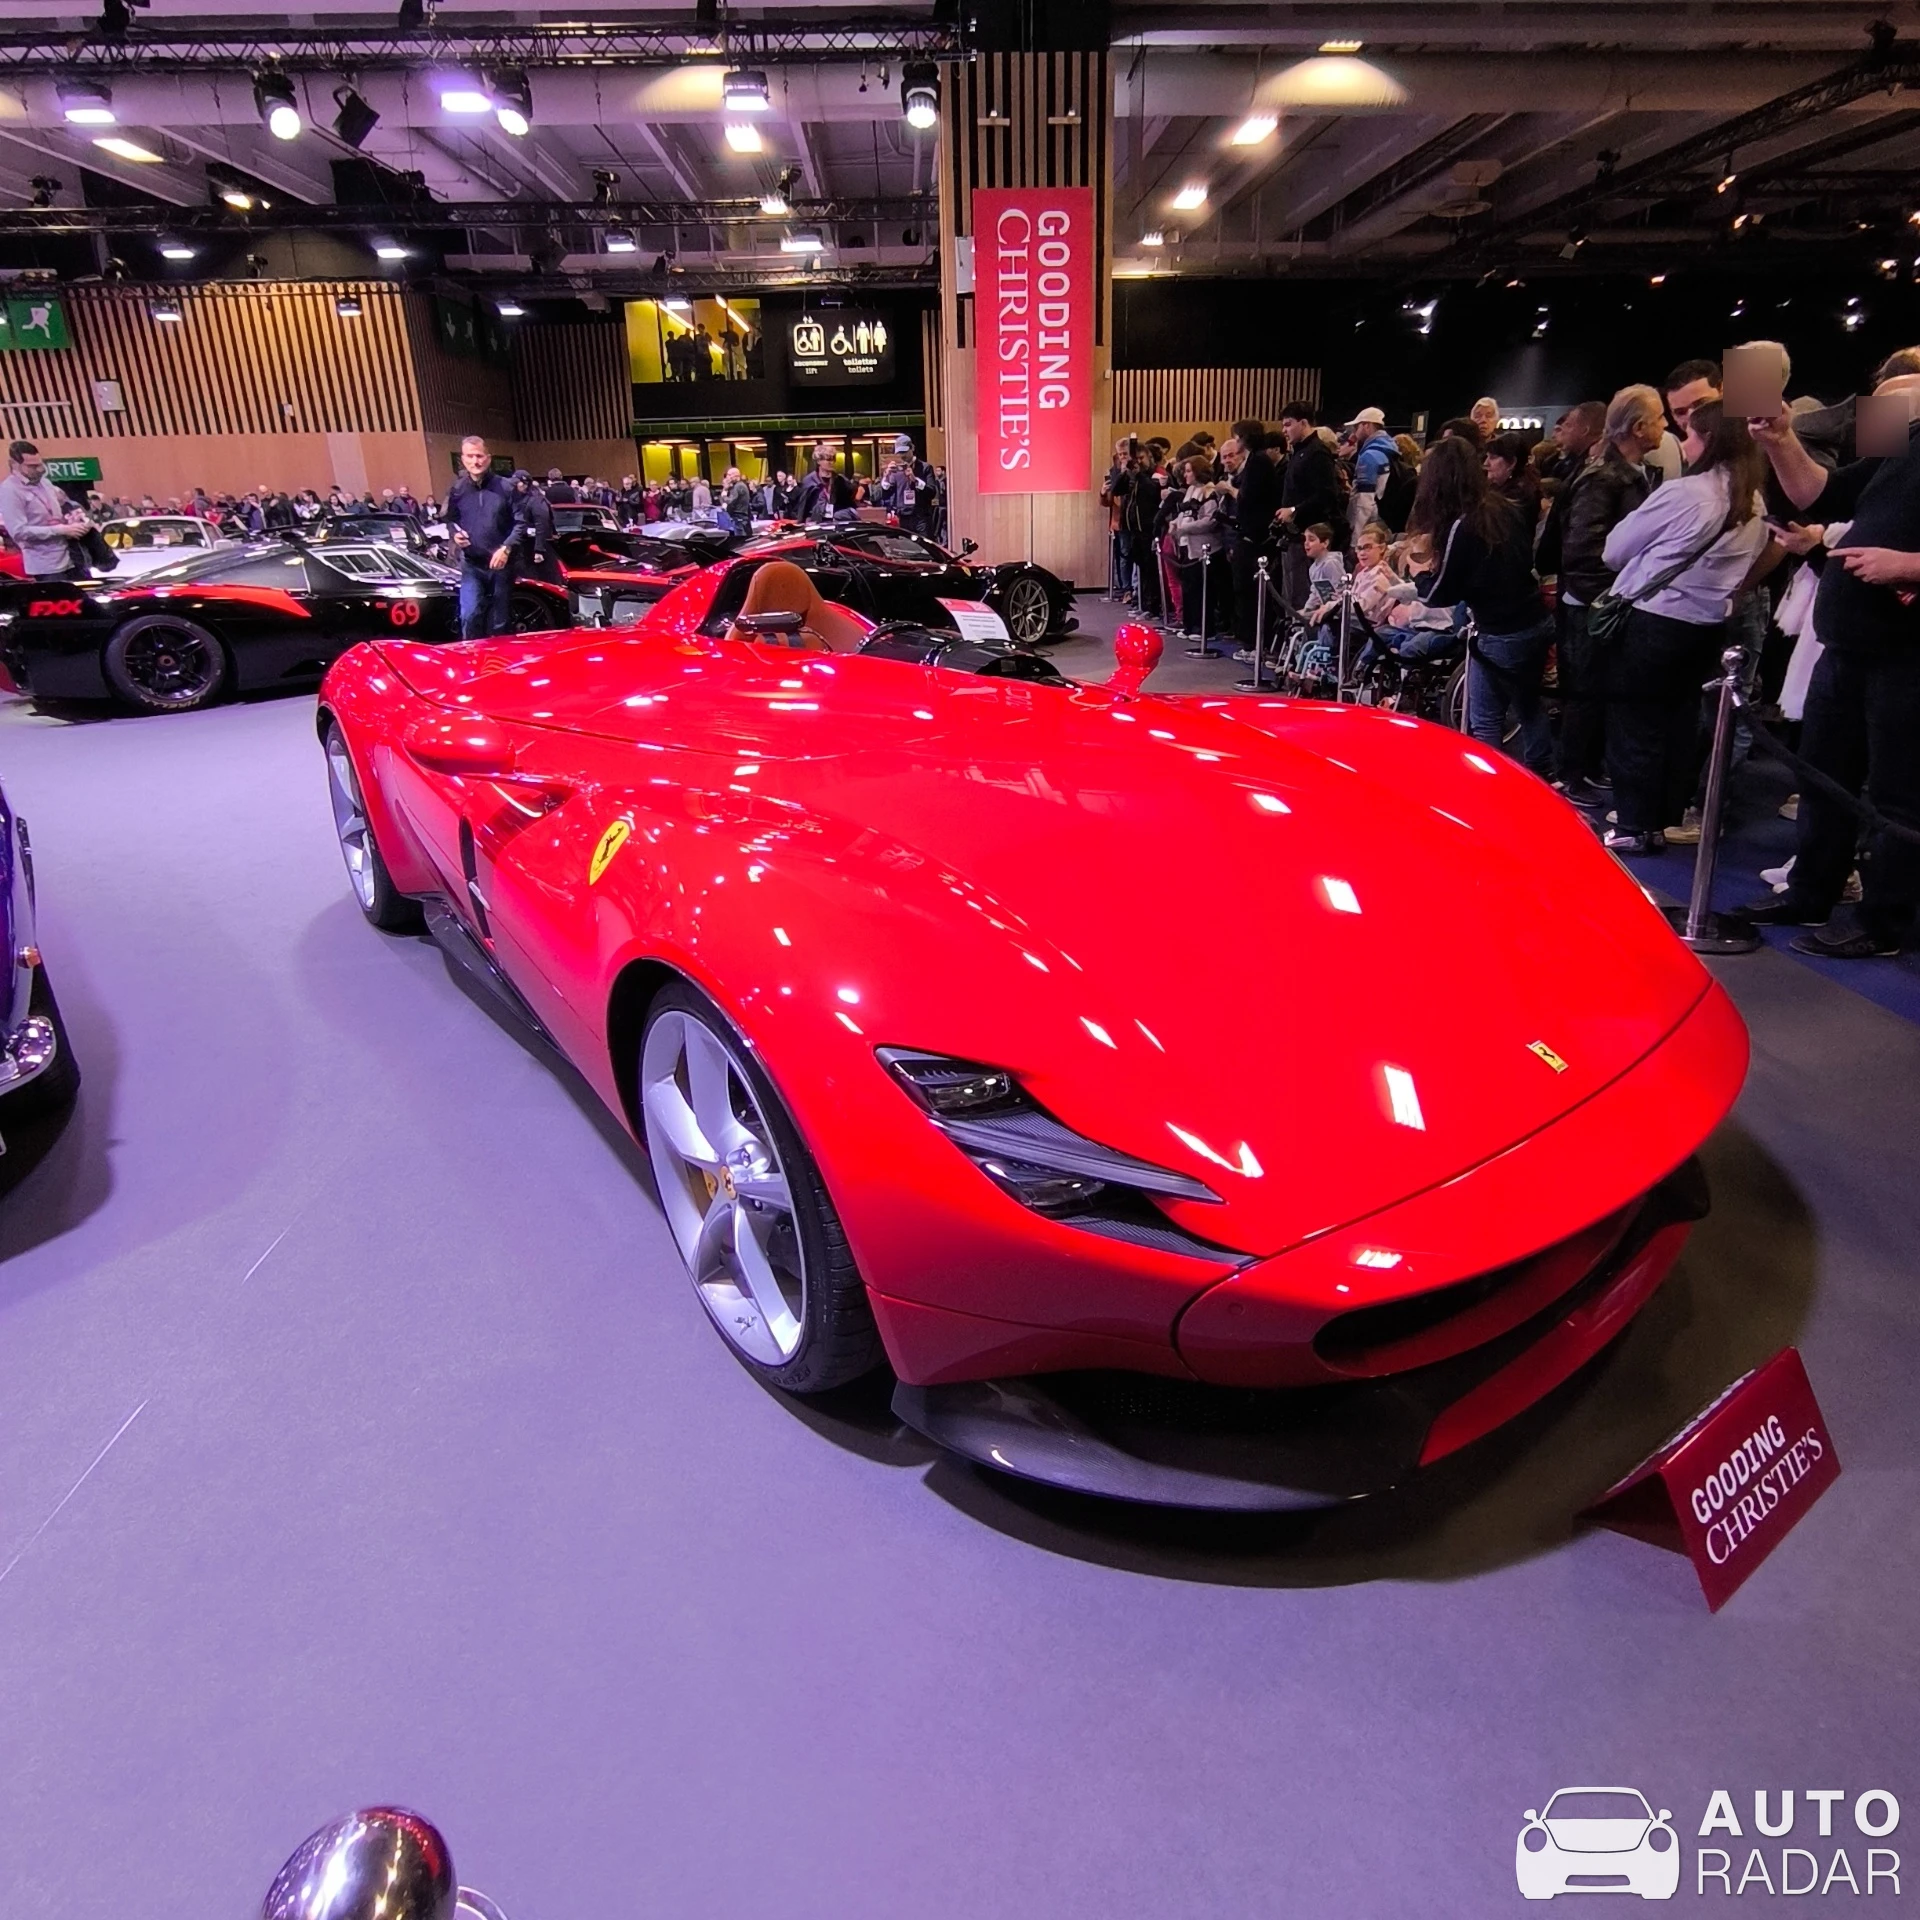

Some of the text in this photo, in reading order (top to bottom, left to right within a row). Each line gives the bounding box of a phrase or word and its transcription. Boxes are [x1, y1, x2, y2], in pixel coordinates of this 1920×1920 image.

[1038, 210, 1070, 409] GOODING
[997, 208, 1031, 470] CHRISTIE'S
[805, 367, 818, 375] lift
[843, 358, 878, 366] toilettes
[848, 365, 874, 374] toilets
[29, 601, 82, 617] FXX
[391, 599, 420, 625] 69
[1691, 1415, 1786, 1524] GOODING
[1706, 1428, 1823, 1564] CHRISTIE'S
